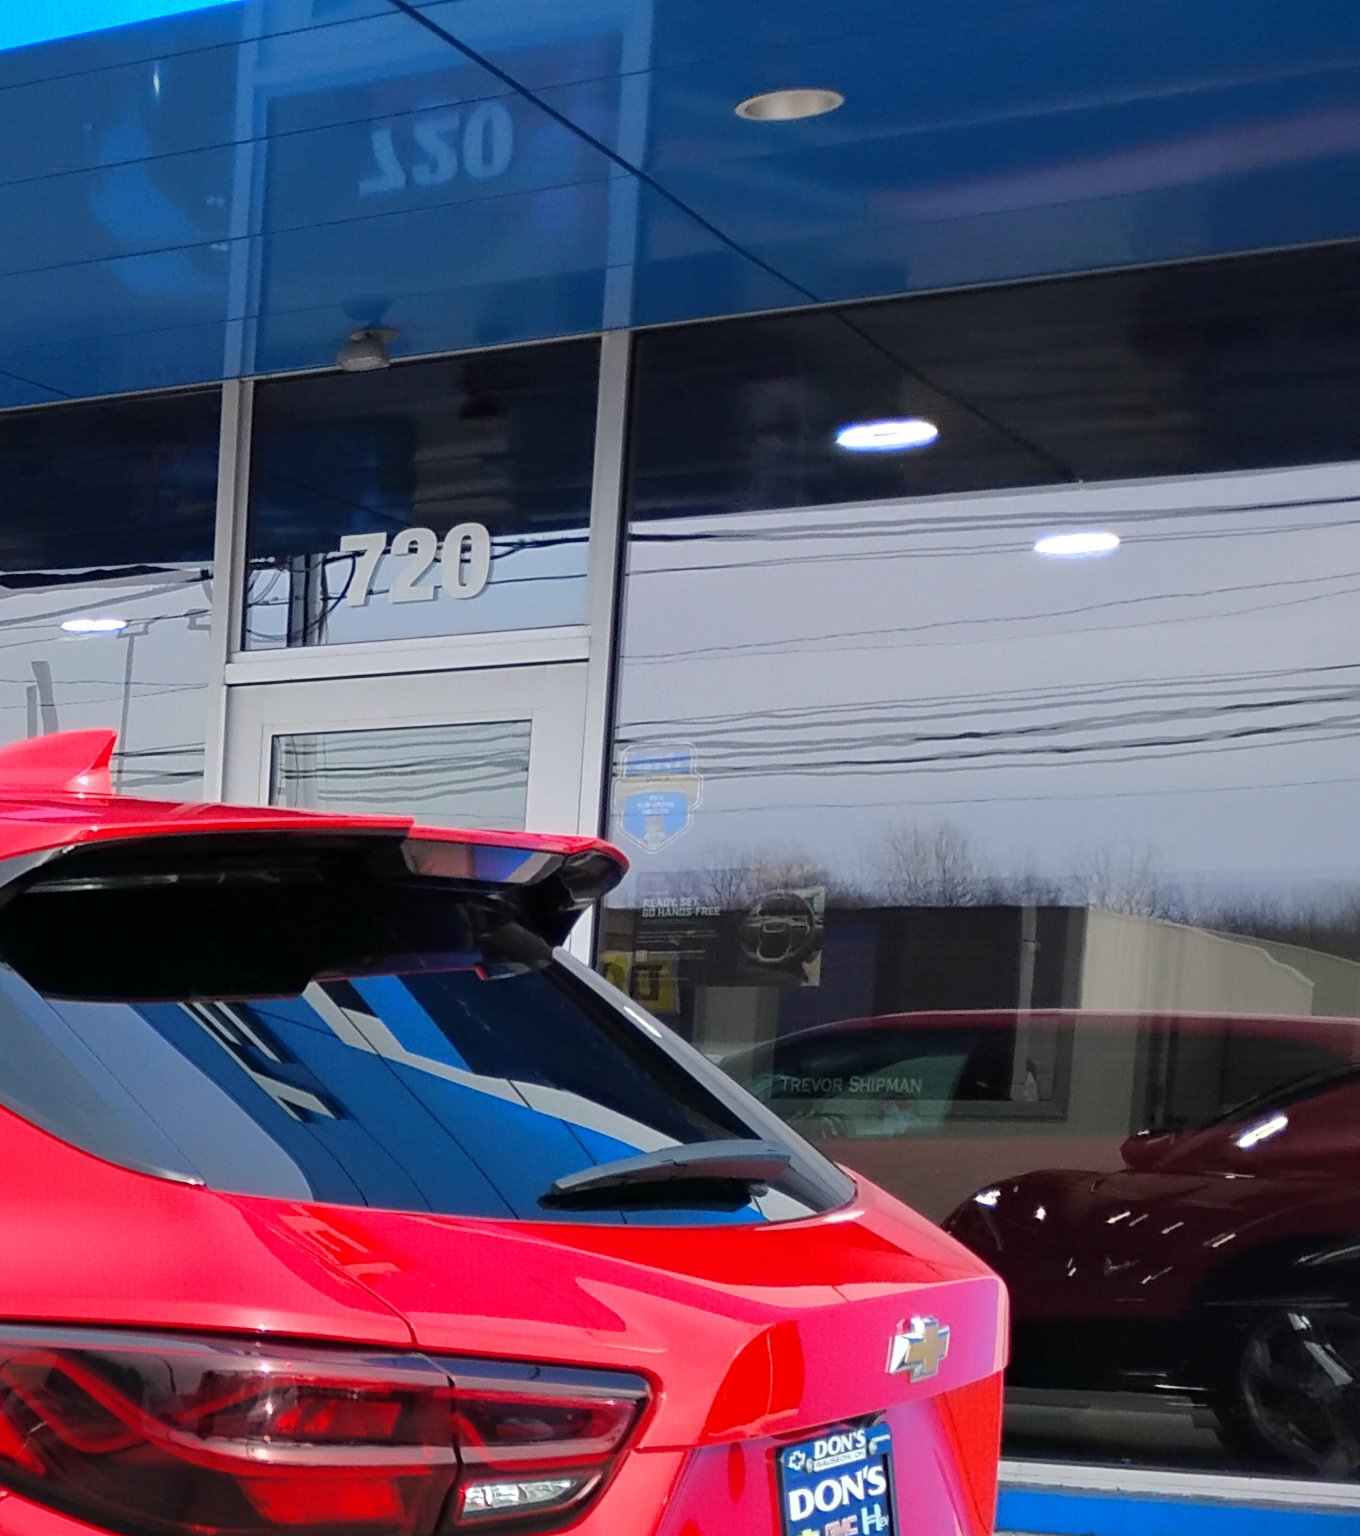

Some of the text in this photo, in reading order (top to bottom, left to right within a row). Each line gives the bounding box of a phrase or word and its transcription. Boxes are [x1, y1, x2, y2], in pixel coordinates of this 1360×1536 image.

[339, 521, 493, 608] 720
[848, 1075, 923, 1093] SHIPMAN
[813, 1429, 867, 1460] DON'S
[788, 1465, 887, 1522] DON'S
